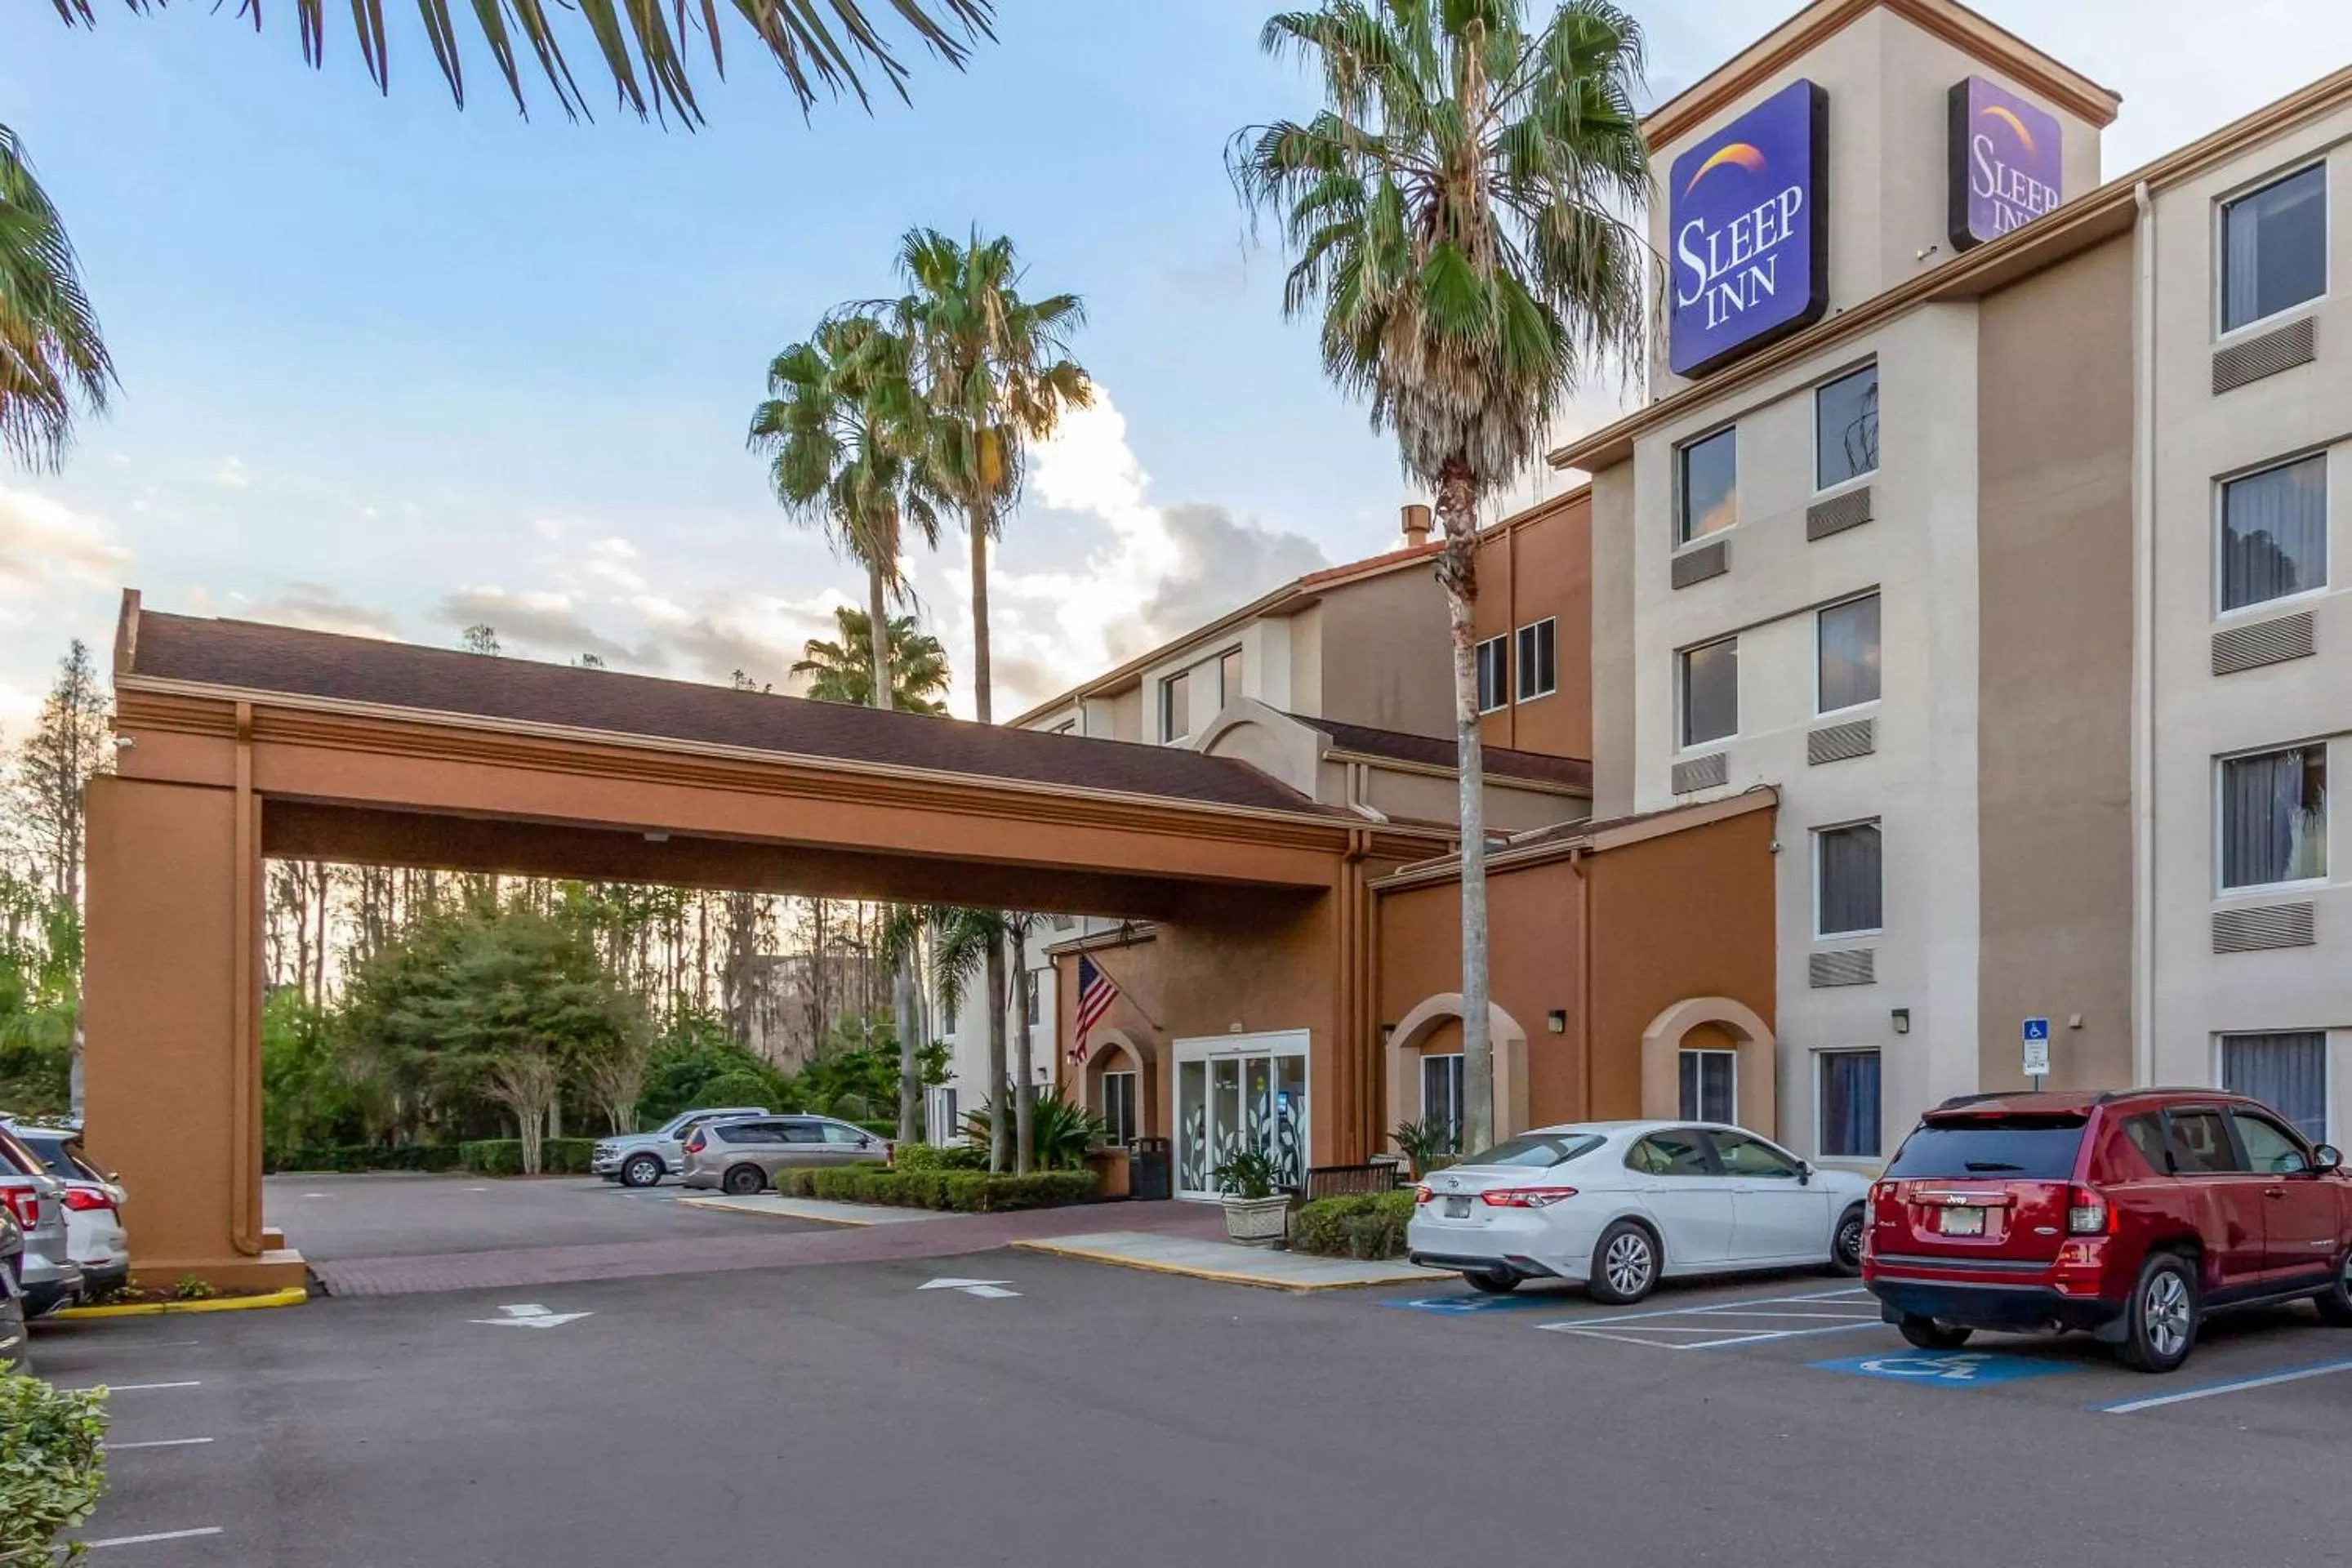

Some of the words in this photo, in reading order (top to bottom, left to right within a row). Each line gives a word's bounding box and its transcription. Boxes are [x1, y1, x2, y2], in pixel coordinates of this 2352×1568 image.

[1972, 134, 2058, 214] SLEEP
[1677, 185, 1802, 309] SLEEP
[1993, 198, 2031, 234] IN
[1704, 253, 1778, 330] INN
